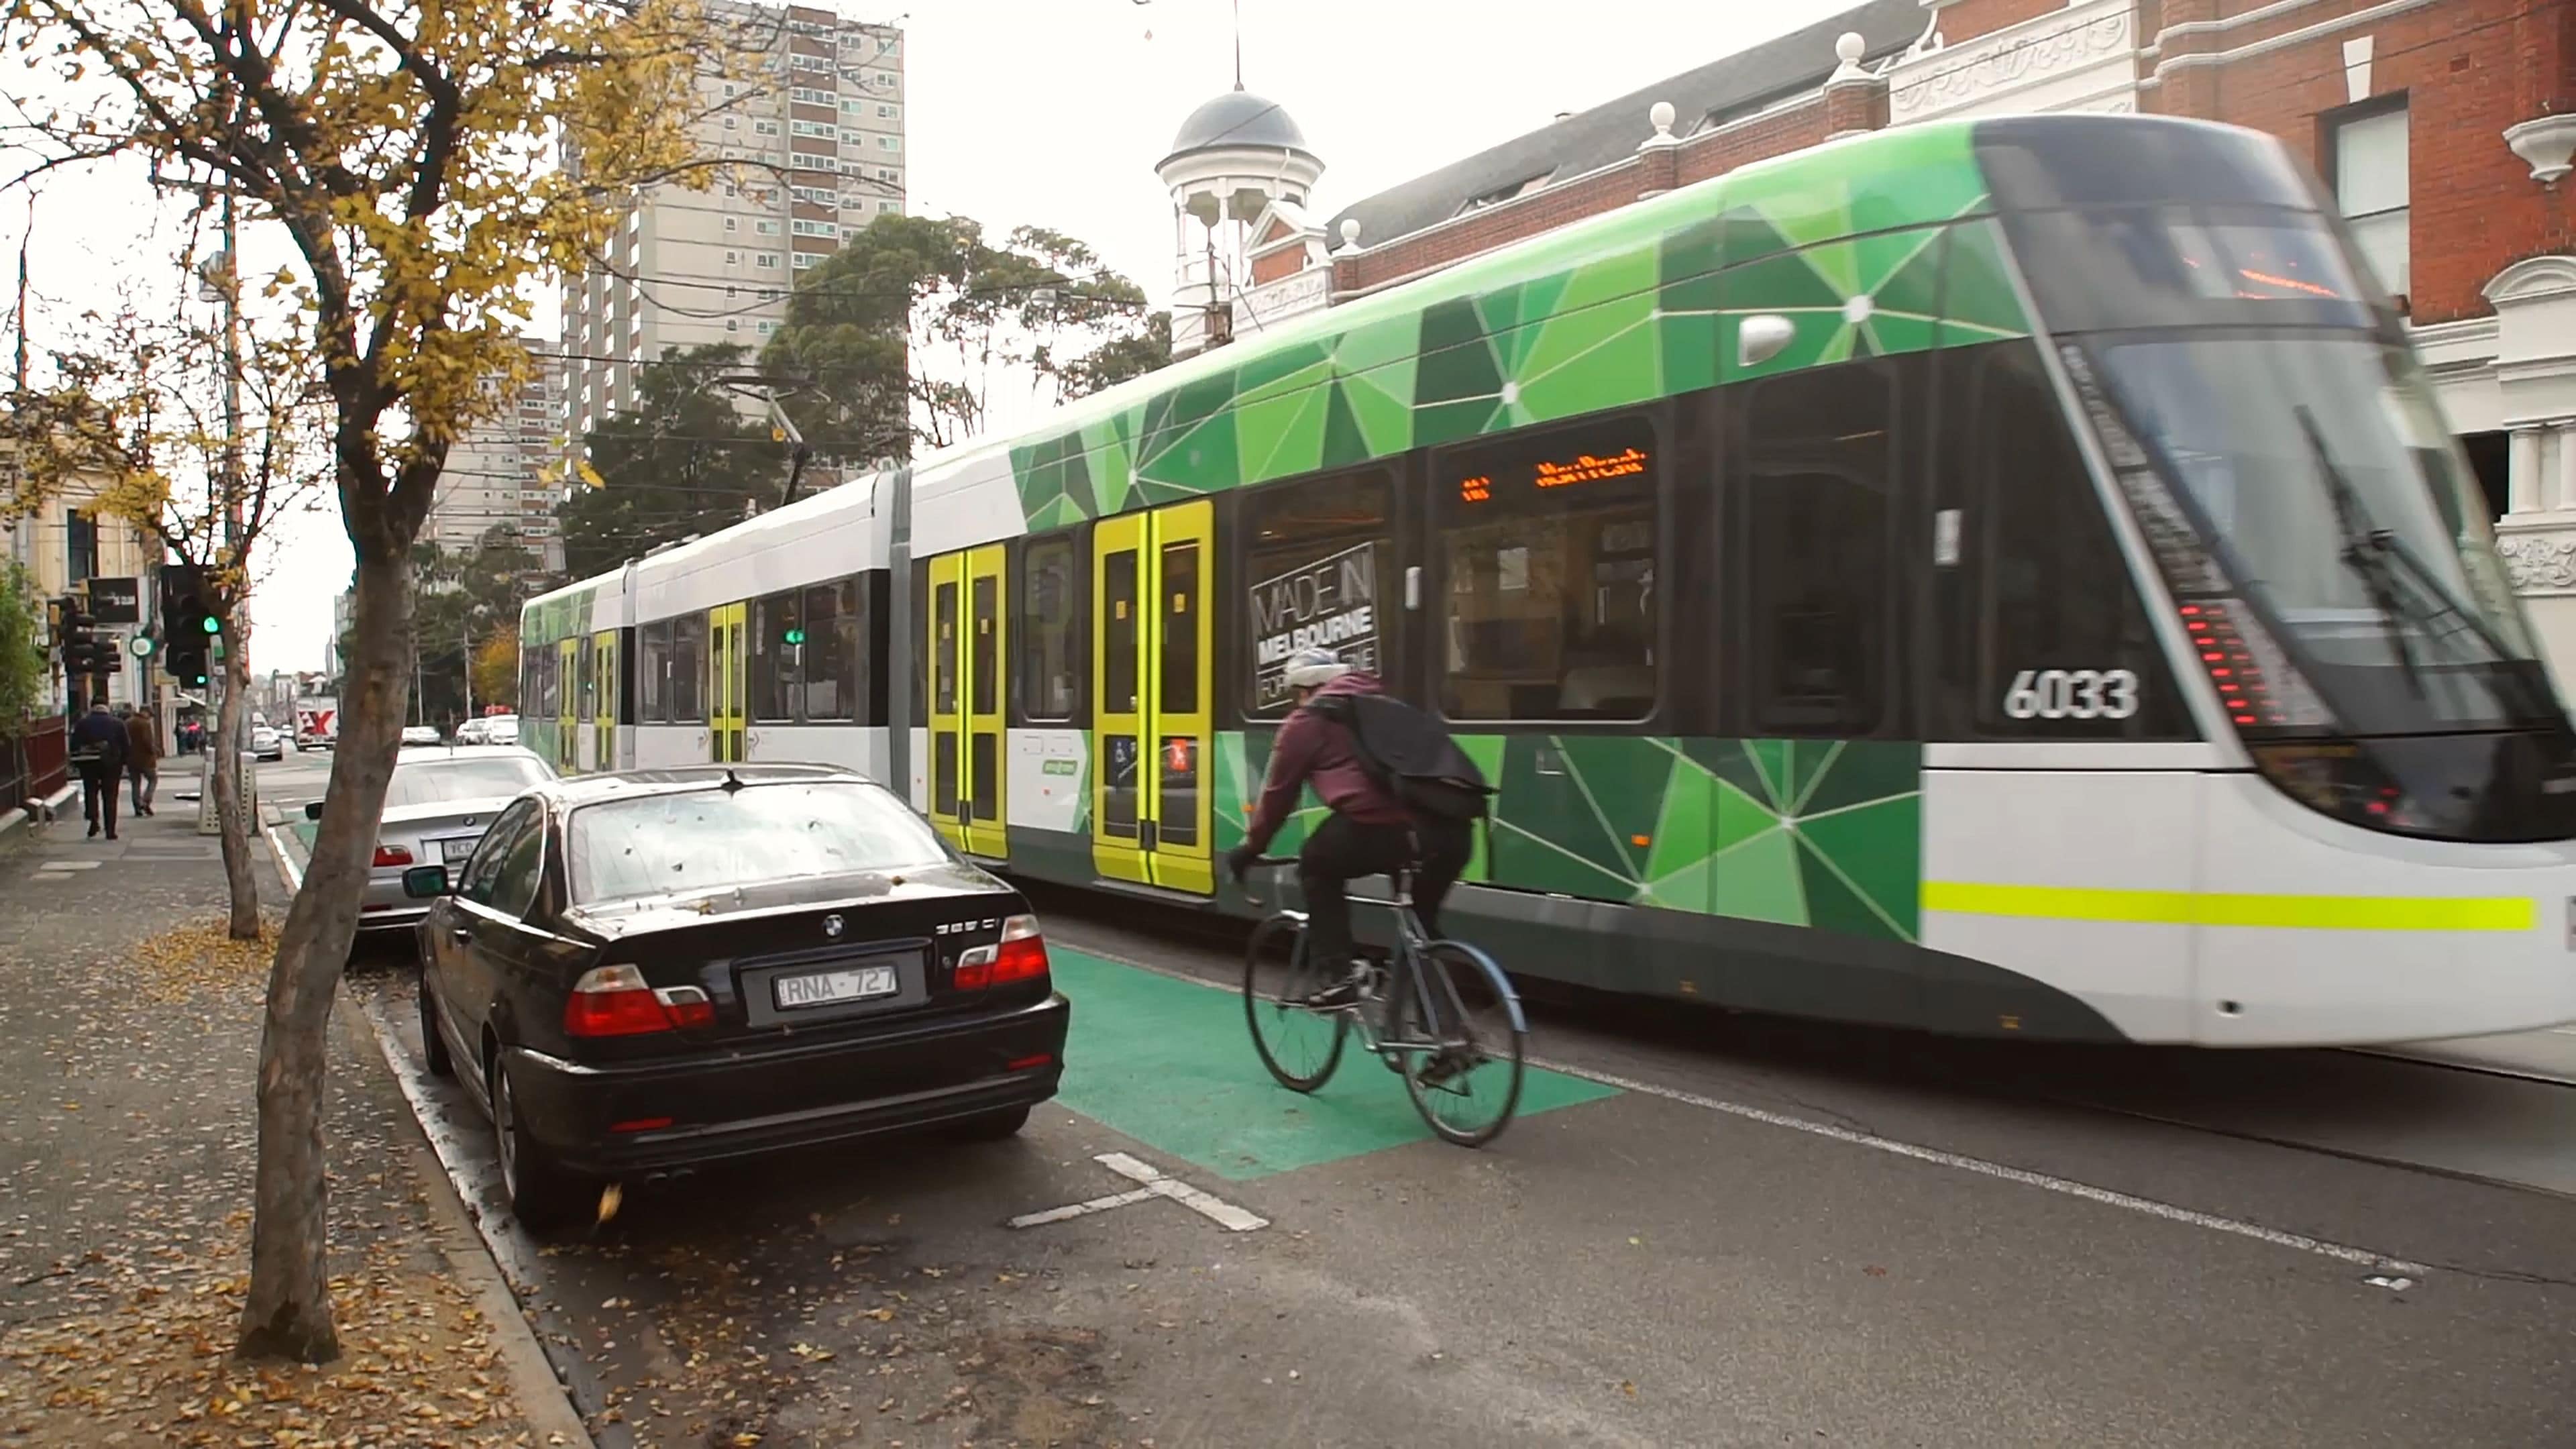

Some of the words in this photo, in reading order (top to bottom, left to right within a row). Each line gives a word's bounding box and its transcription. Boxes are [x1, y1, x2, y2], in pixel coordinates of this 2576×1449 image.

[1254, 565, 1337, 635] MADE
[1340, 551, 1372, 605] IN
[1258, 605, 1373, 665] MELBOURNE
[2003, 669, 2139, 718] 6033
